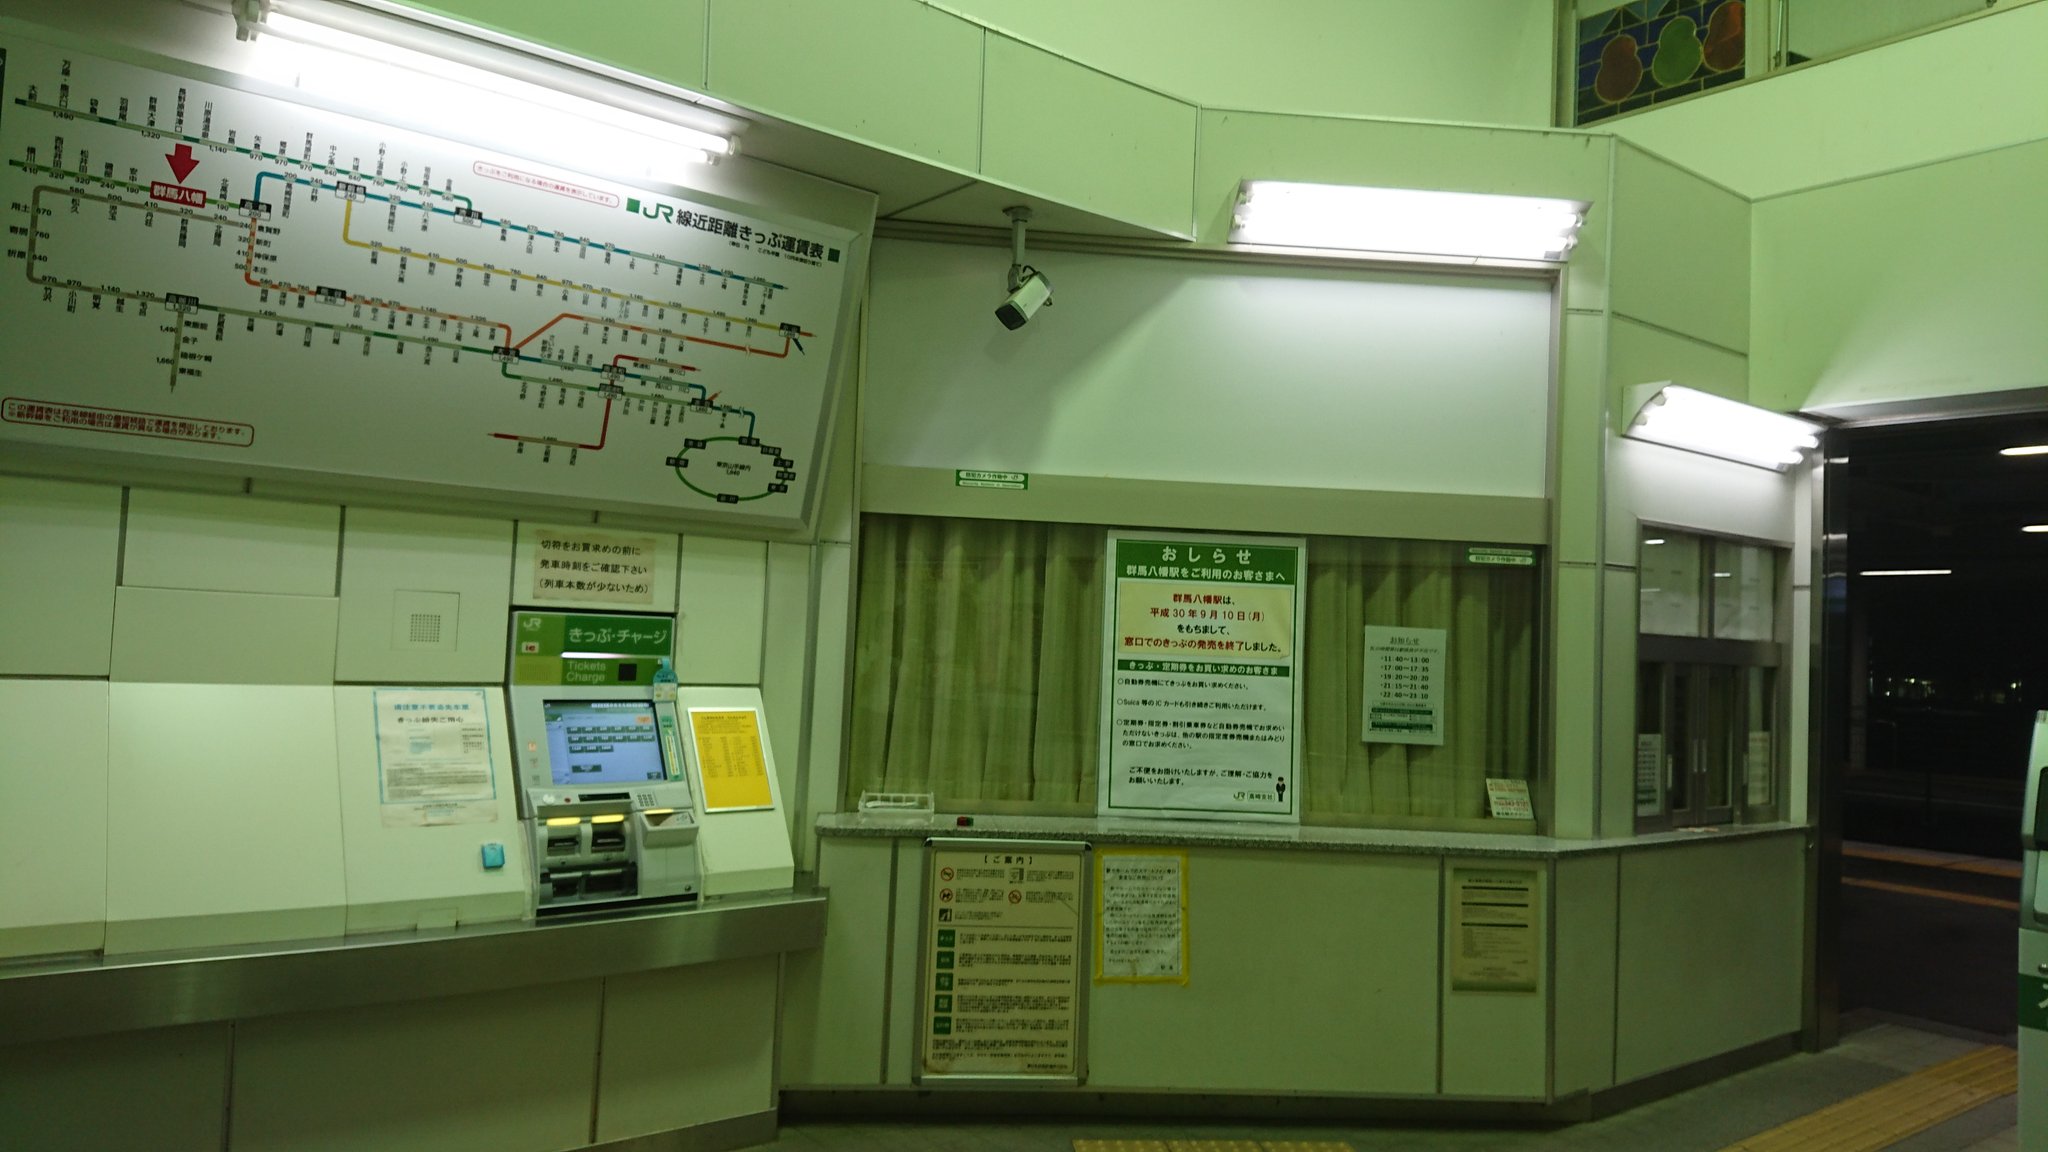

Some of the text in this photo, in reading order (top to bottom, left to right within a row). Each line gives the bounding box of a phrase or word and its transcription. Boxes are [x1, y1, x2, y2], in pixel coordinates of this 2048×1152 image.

[53, 110, 74, 121] 1,490
[141, 130, 160, 140] 1,320
[209, 145, 227, 153] 1,140
[79, 149, 89, 174] 松井田
[250, 153, 263, 161] 970
[22, 166, 38, 175] 410
[299, 164, 313, 172] 970
[49, 171, 64, 180] 320
[129, 167, 138, 182] 安中
[284, 172, 297, 180] 200
[75, 175, 91, 185] 320
[310, 177, 323, 185] 240
[100, 182, 115, 190] 240
[126, 186, 139, 195] 190
[107, 193, 122, 202] 500
[153, 186, 204, 205] 群馬八幡
[11, 202, 30, 213] 用土
[144, 201, 158, 209] 410
[180, 207, 193, 215] 320
[234, 263, 247, 271] 500
[253, 266, 268, 275] 本庄
[42, 275, 57, 284] 970
[66, 279, 82, 287] 970
[101, 285, 121, 294] 1,140
[67, 291, 77, 313] 小川町
[159, 325, 178, 334] 1,490
[182, 335, 198, 344] 金子
[541, 540, 641, 556] 切符をお買求めの前に
[540, 559, 647, 575] 発車時刻をご確認下さい
[1126, 565, 1286, 582] 群馬八幡駅をご利用のお客さまへ
[1172, 593, 1236, 606] 群馬八幡駅は、
[1177, 624, 1230, 636] をもちまして、
[568, 628, 668, 645] きっぷ・チャージ
[1124, 636, 1282, 653] 窓口でのきっぷの発売を終了しました。
[567, 660, 606, 670] Tickets
[1129, 661, 1278, 676] きっぷ・定期券をお買い求めのお客さま
[566, 672, 605, 684] Charge
